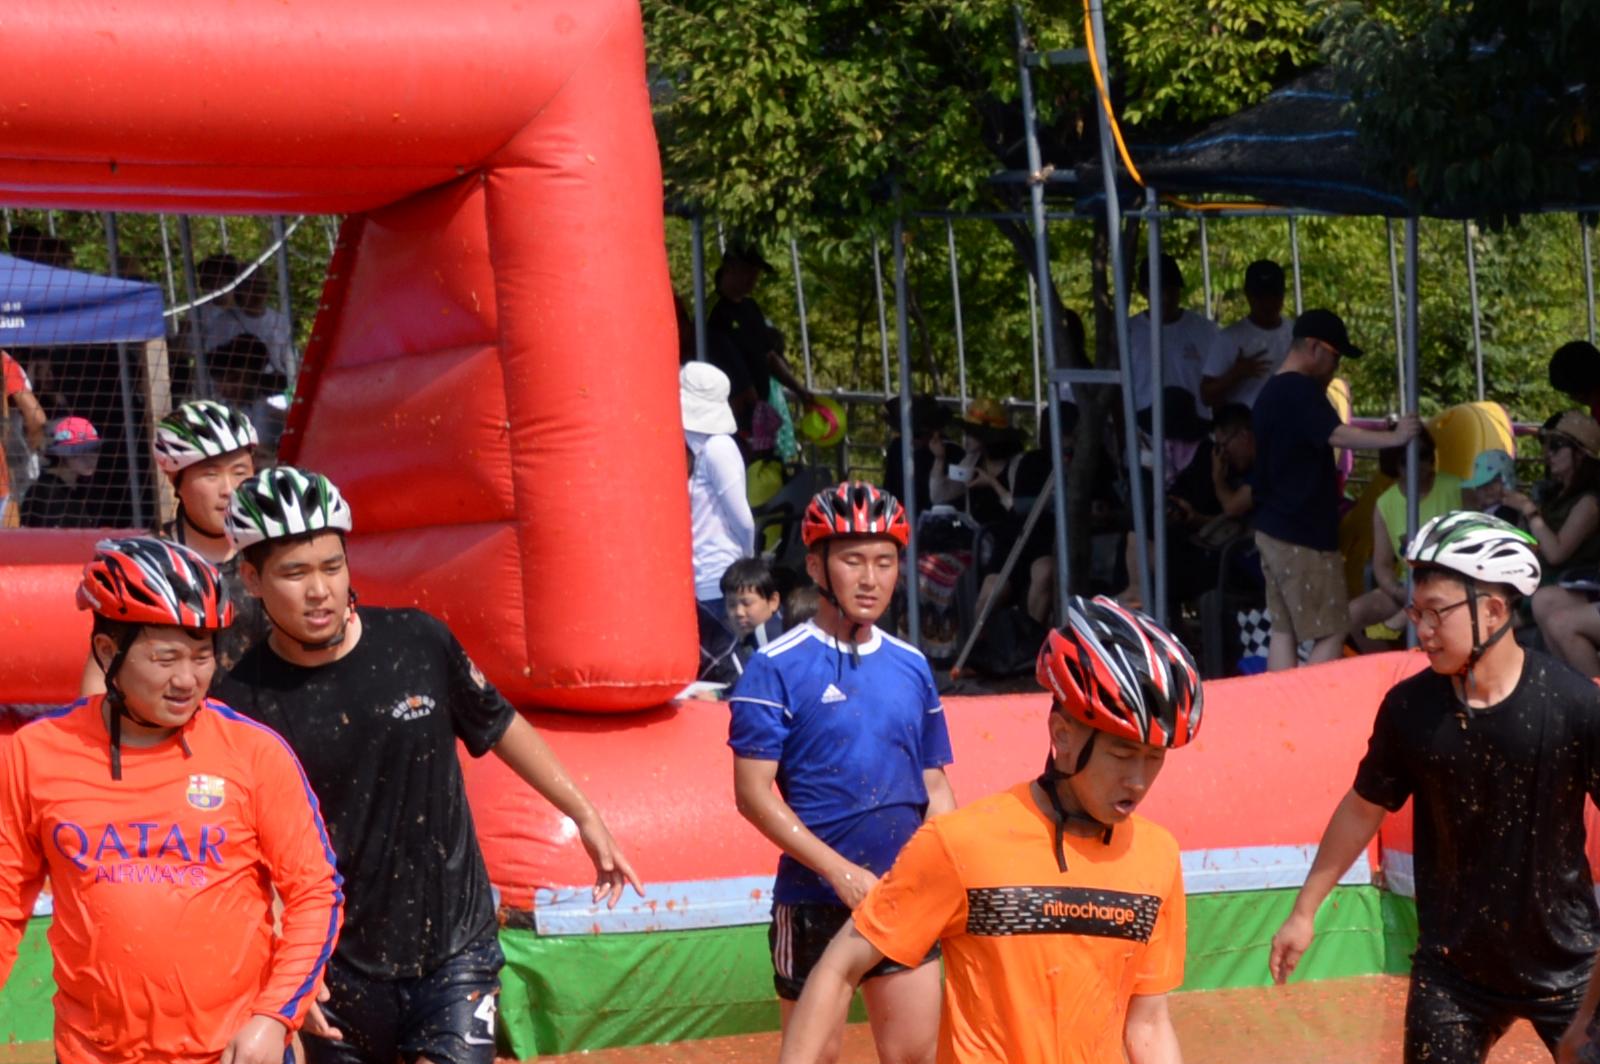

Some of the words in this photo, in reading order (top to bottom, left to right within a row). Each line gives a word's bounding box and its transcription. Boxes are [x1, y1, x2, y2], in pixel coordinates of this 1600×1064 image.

[52, 822, 226, 872] QATAR
[95, 863, 207, 887] AIRWAYS
[1043, 901, 1135, 925] nitrocharge
